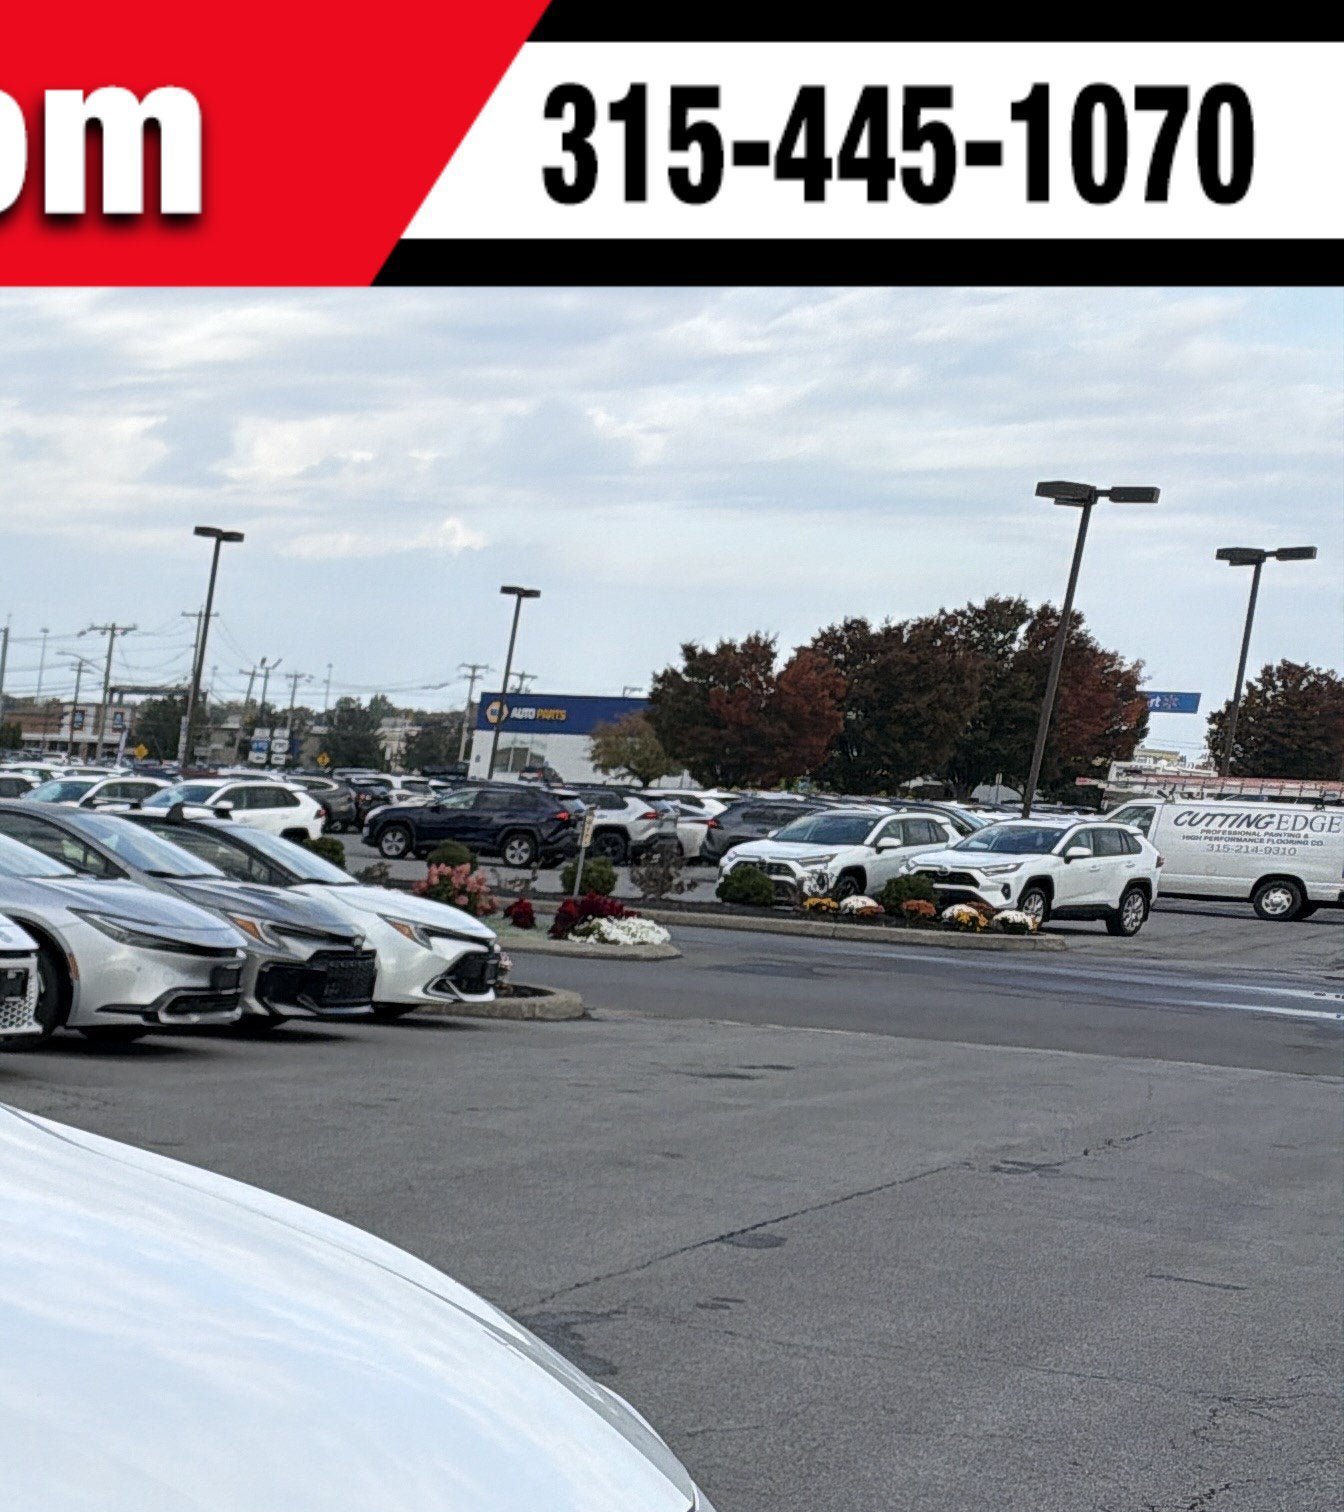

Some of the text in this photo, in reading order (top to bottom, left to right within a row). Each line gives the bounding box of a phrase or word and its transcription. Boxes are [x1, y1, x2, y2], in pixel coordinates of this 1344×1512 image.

[1200, 828, 1261, 837] PROFESSIONAL
[1203, 835, 1264, 844] PERFORMANCE
[1266, 838, 1310, 846] FLOORING
